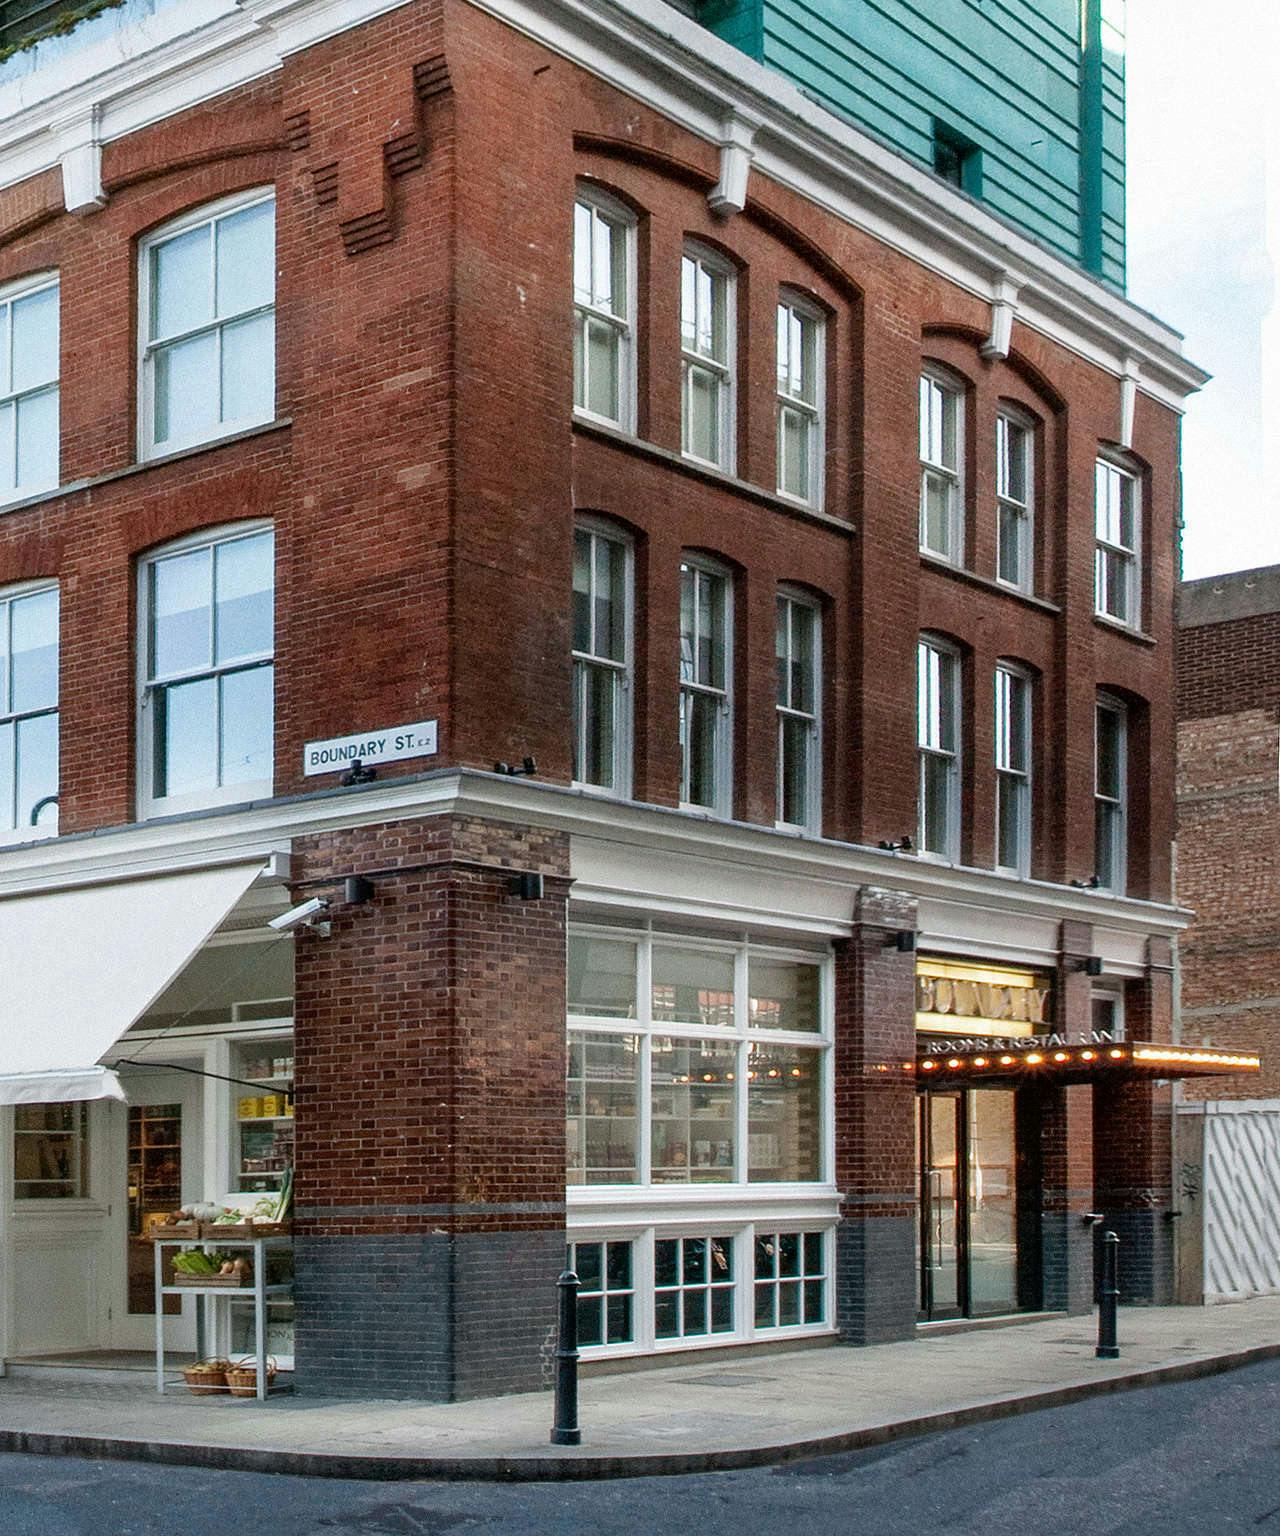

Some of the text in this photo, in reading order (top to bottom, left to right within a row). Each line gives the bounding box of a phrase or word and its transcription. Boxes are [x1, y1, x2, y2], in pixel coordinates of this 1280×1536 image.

[310, 739, 386, 766] BOUNDARY
[395, 734, 415, 751] ST.
[926, 1038, 989, 1055] ROOMS
[992, 1037, 1005, 1049] &
